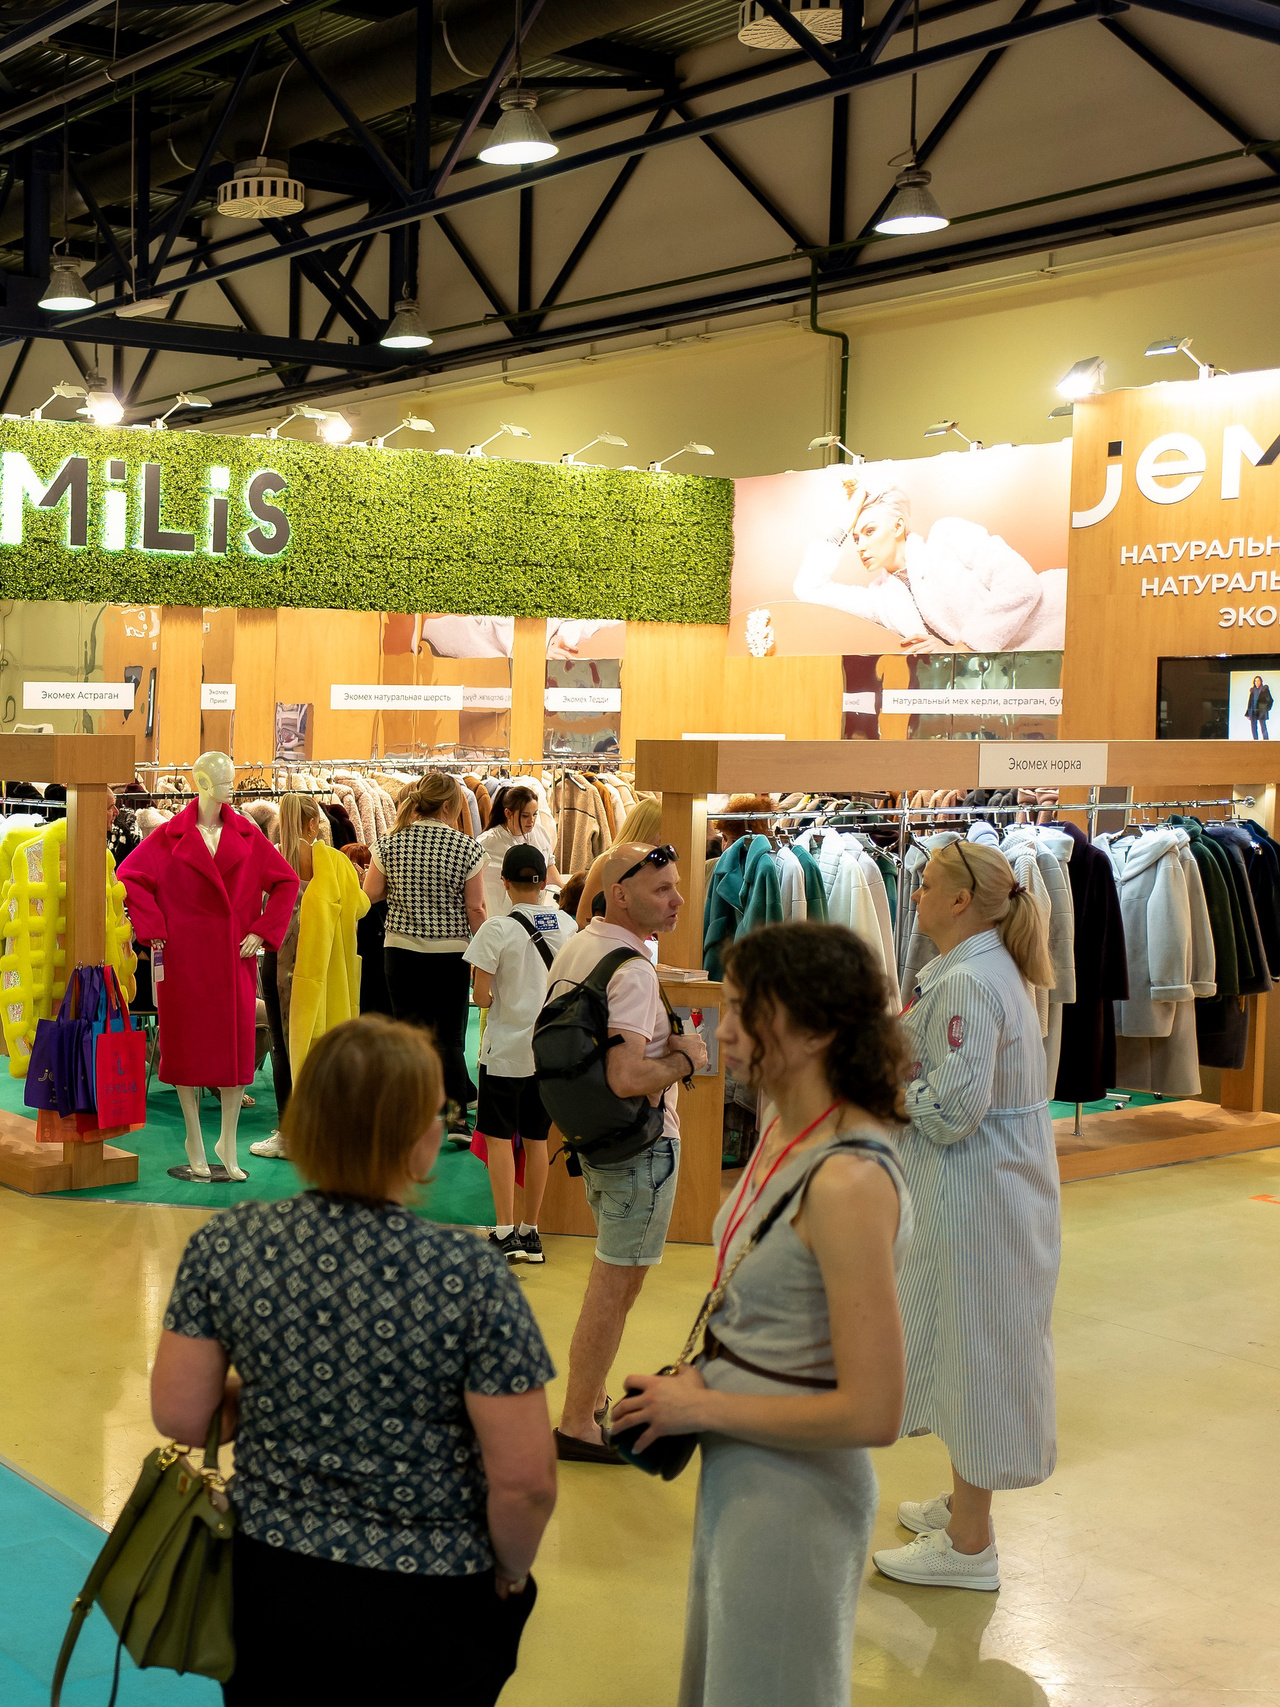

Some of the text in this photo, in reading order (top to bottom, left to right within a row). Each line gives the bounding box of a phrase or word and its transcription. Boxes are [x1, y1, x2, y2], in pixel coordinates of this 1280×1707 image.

[41, 691, 119, 701] Экомех Астраган
[344, 692, 451, 703] Экомех натуральная шерсть
[562, 695, 609, 704] Экомех Тедди
[893, 697, 950, 706] Натуральный
[970, 698, 1001, 707] керли,
[1003, 697, 1047, 706] астраган,
[1008, 757, 1082, 773] Экомех норка
